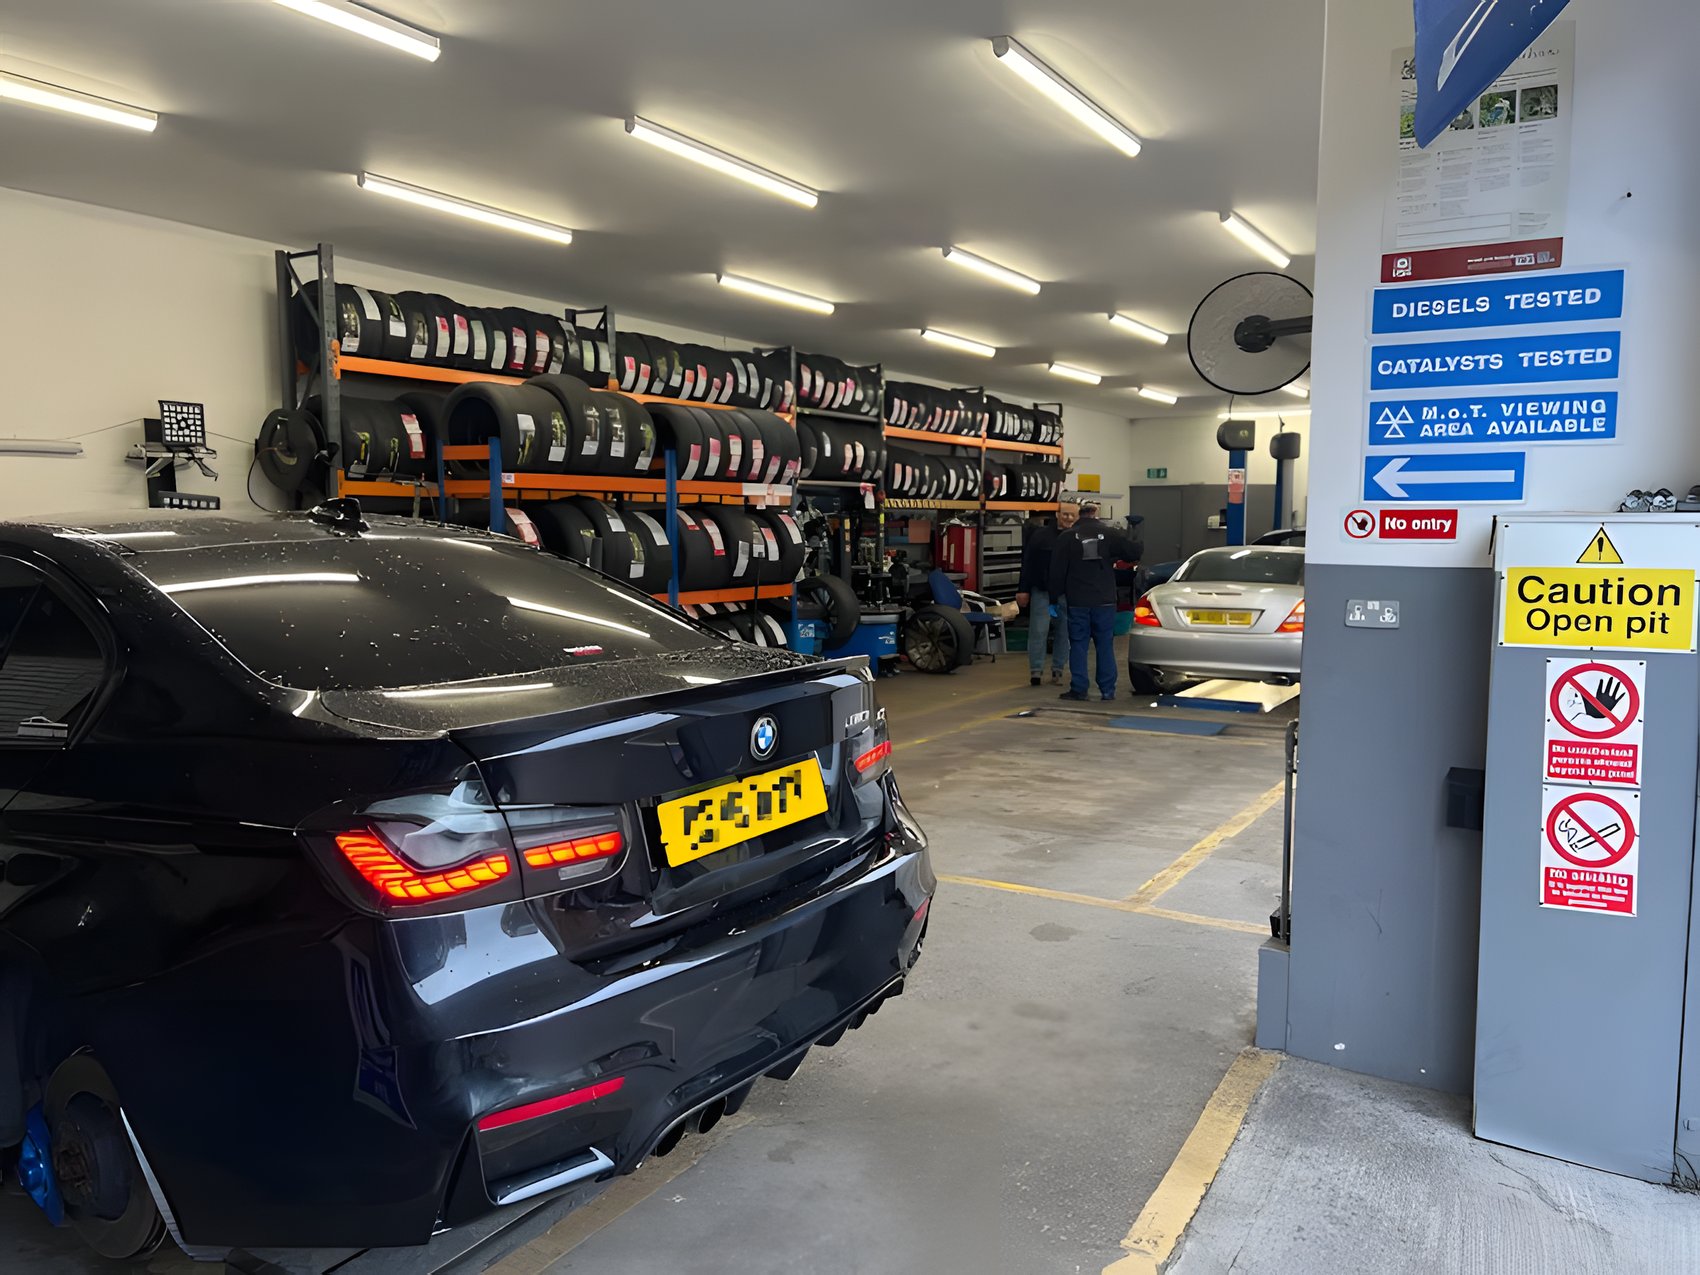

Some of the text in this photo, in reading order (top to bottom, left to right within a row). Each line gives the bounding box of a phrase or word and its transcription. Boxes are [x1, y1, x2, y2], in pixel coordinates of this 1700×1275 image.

[1392, 288, 1602, 318] DIESELS TESTED
[1377, 348, 1613, 375] CATALYSTS TESTED
[1501, 399, 1607, 416] VIEWING
[1420, 417, 1606, 437] AREA AVAILABLE
[1384, 517, 1452, 533] No entry
[1517, 575, 1681, 606] Caution
[1526, 608, 1670, 639] Open pit
